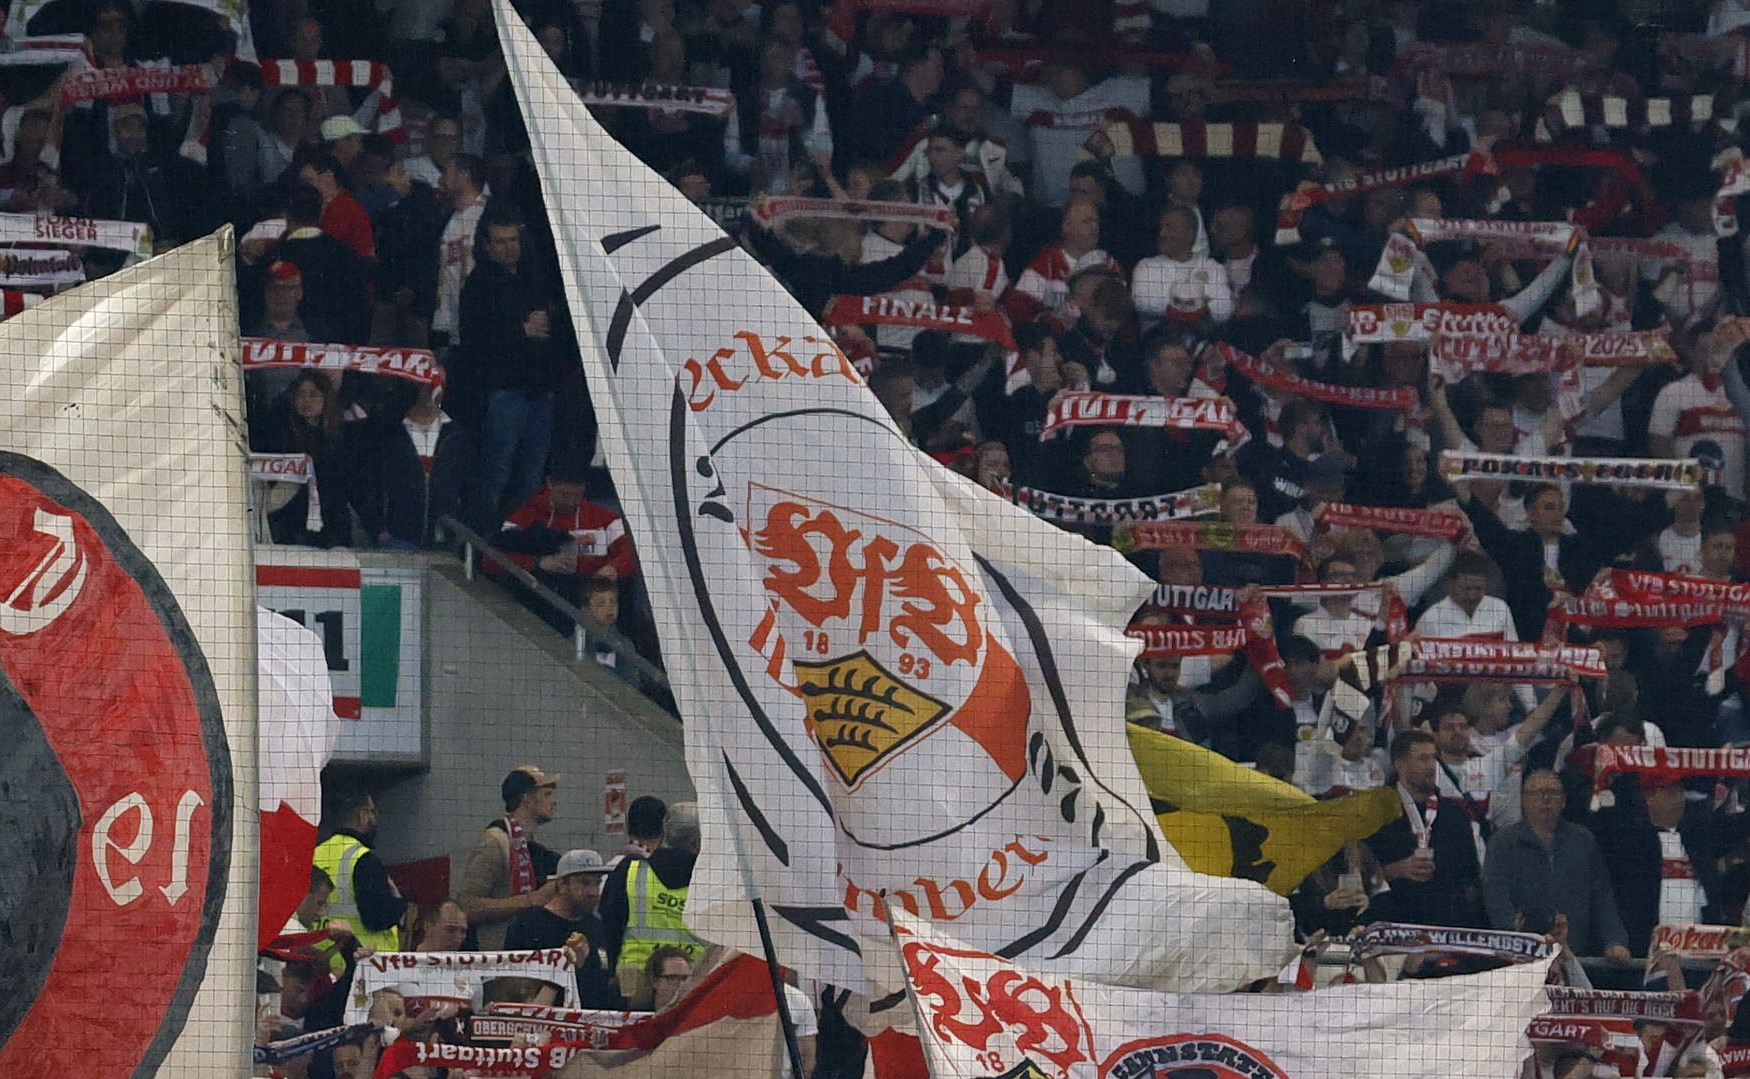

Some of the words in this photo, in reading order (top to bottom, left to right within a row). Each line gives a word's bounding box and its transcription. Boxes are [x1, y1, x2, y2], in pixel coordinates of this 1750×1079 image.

[1149, 585, 1240, 612] TUTTGART
[1668, 576, 1750, 603] STUTTGA
[803, 630, 830, 654] 18
[898, 653, 931, 679] 93
[1664, 748, 1750, 771] STUTTGA
[370, 954, 417, 975] VfB
[1527, 1022, 1592, 1040] TGART
[416, 1041, 542, 1069] Stuttgart
[976, 1050, 1005, 1072] 18
